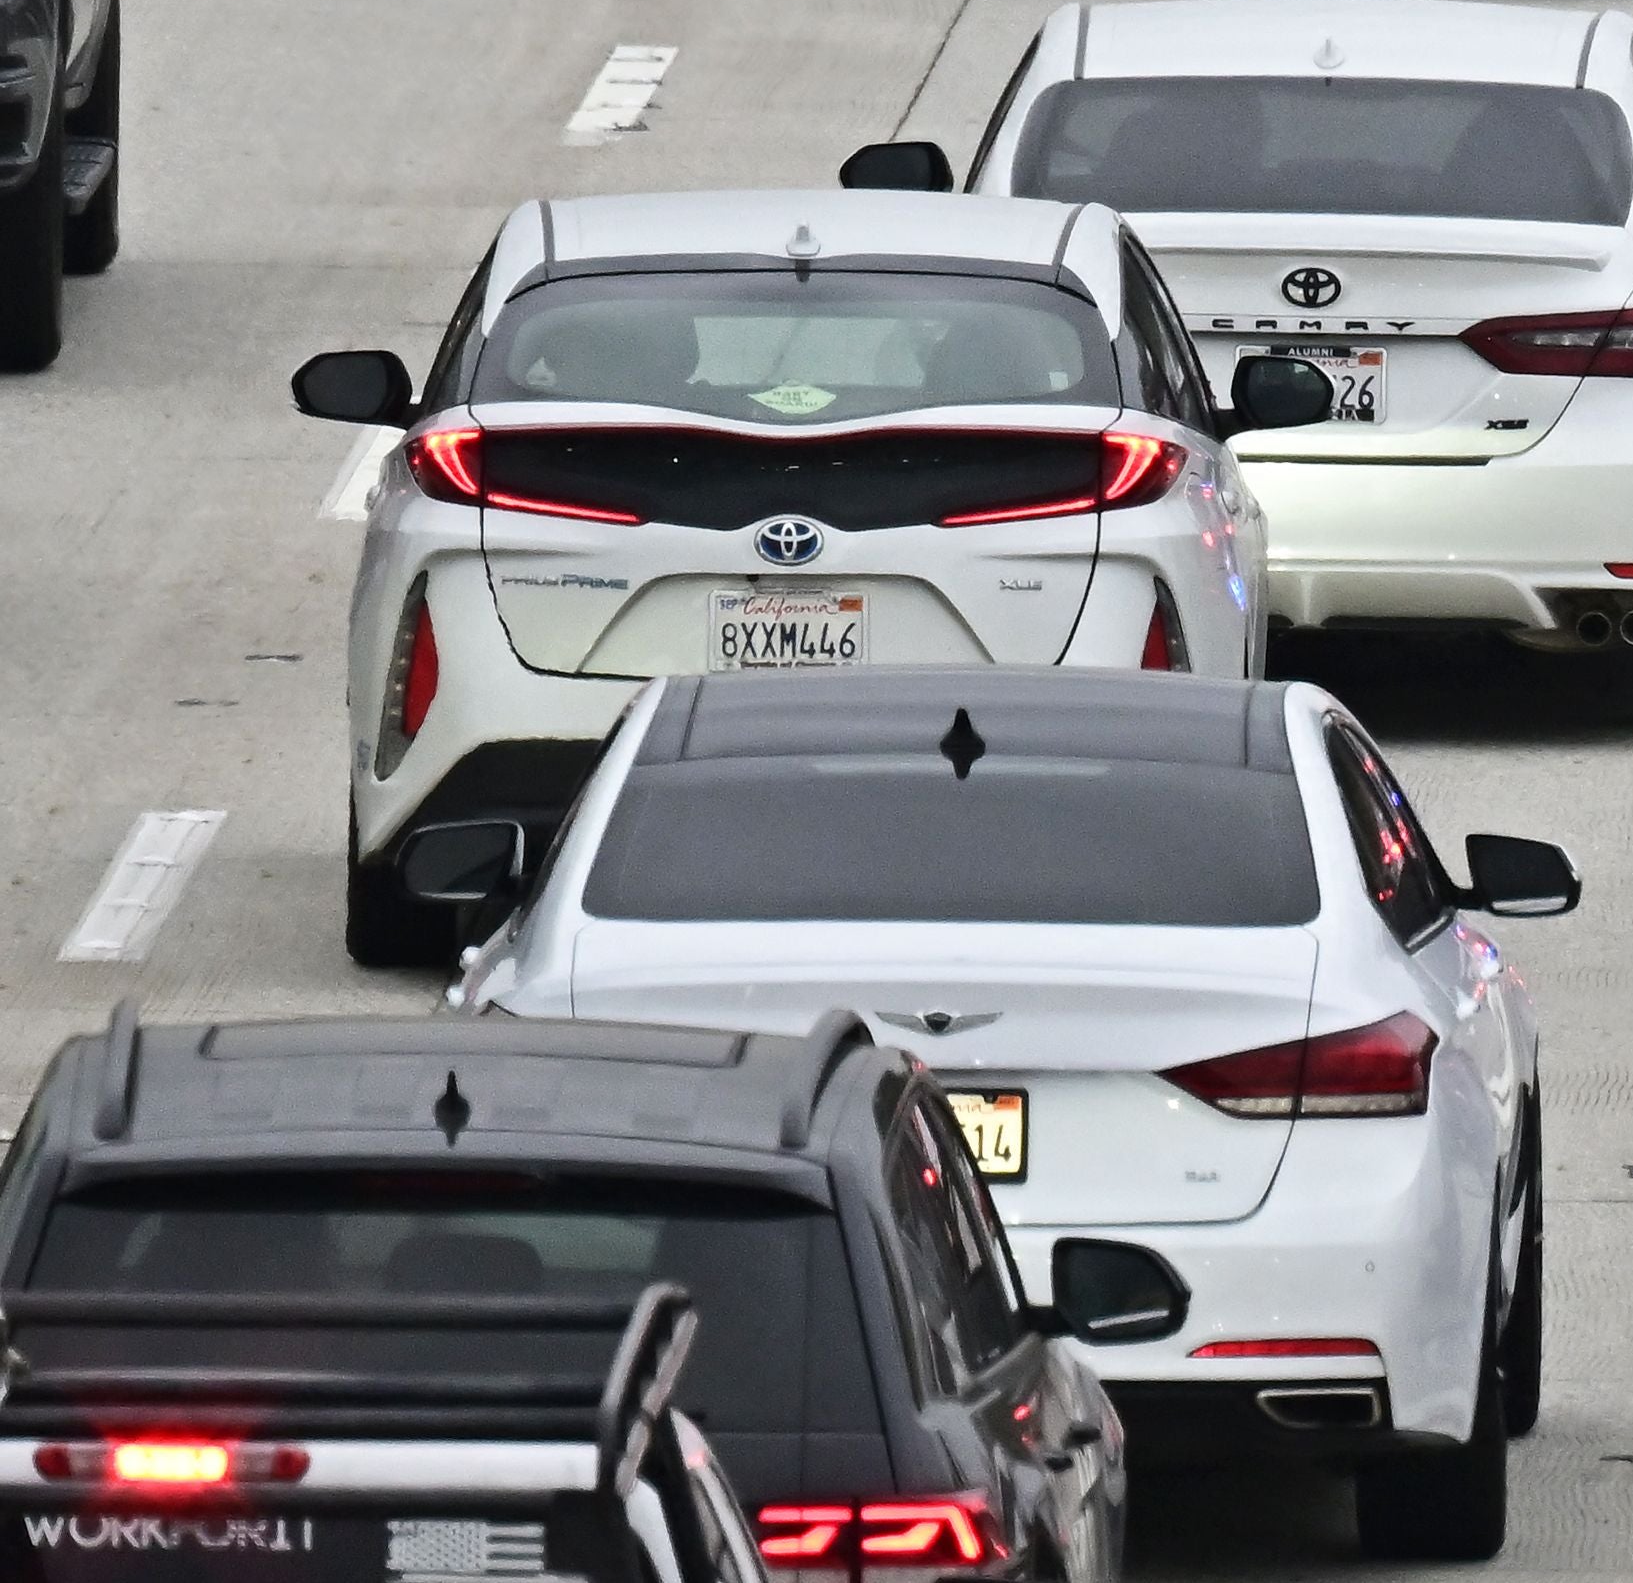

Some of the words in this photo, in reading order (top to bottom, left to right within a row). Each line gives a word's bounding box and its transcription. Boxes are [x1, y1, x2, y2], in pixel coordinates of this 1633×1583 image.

[1212, 319, 1415, 331] CAMRY
[1287, 347, 1334, 356] ALUMNI
[744, 597, 838, 621] California
[722, 623, 856, 658] 8XXM446
